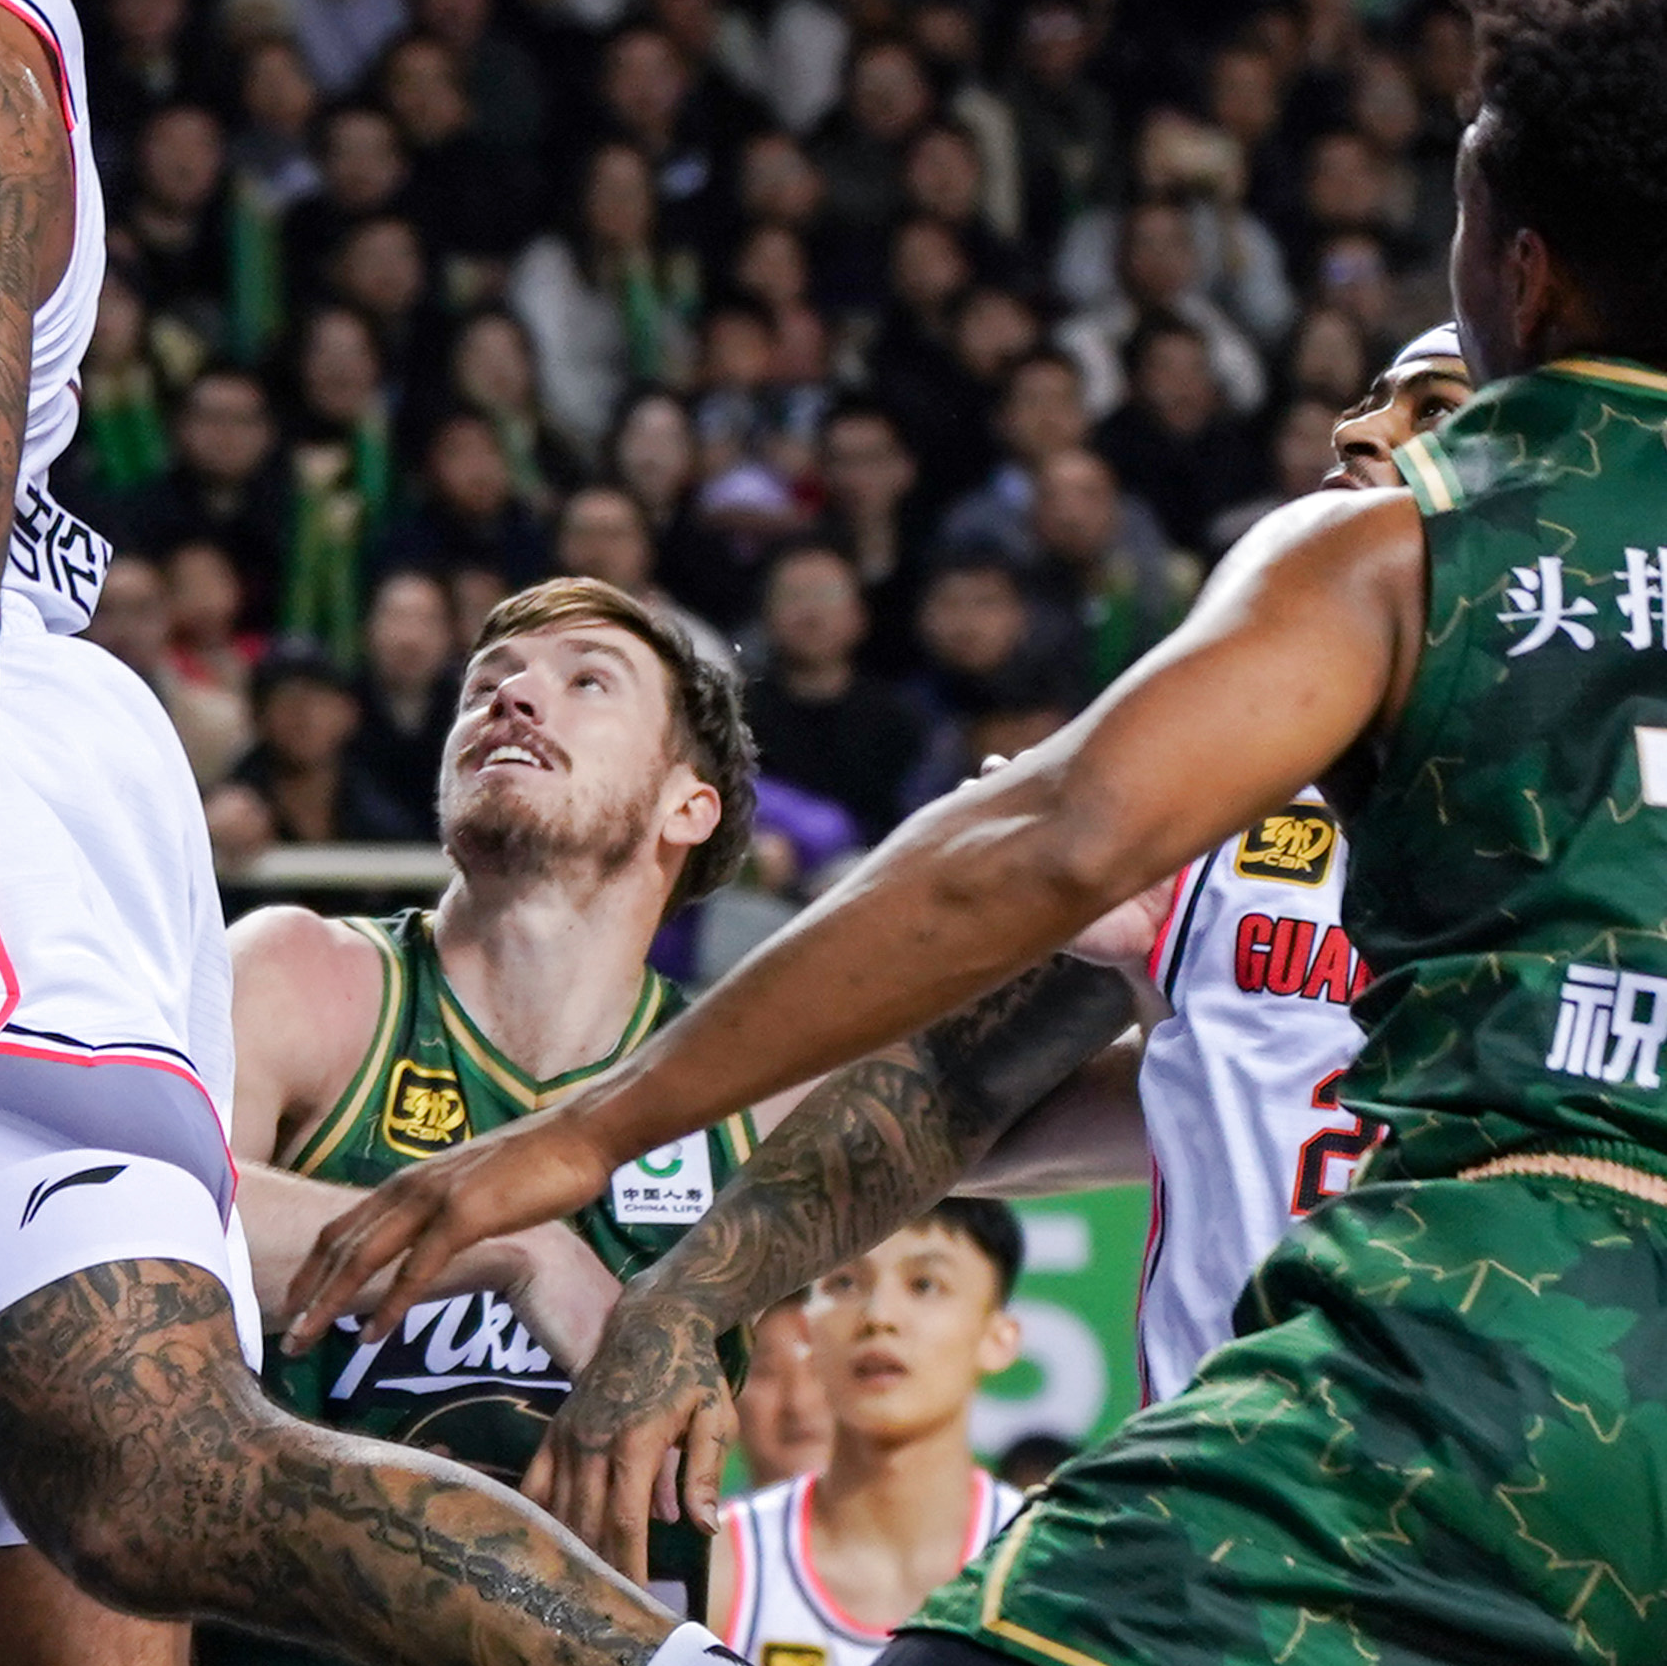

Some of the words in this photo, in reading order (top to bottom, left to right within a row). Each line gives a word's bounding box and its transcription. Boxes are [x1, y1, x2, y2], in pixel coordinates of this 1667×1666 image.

[622, 1187, 704, 1203] 中国人寿
[623, 1203, 669, 1213] CHINA
[672, 1204, 704, 1213] LIFE
